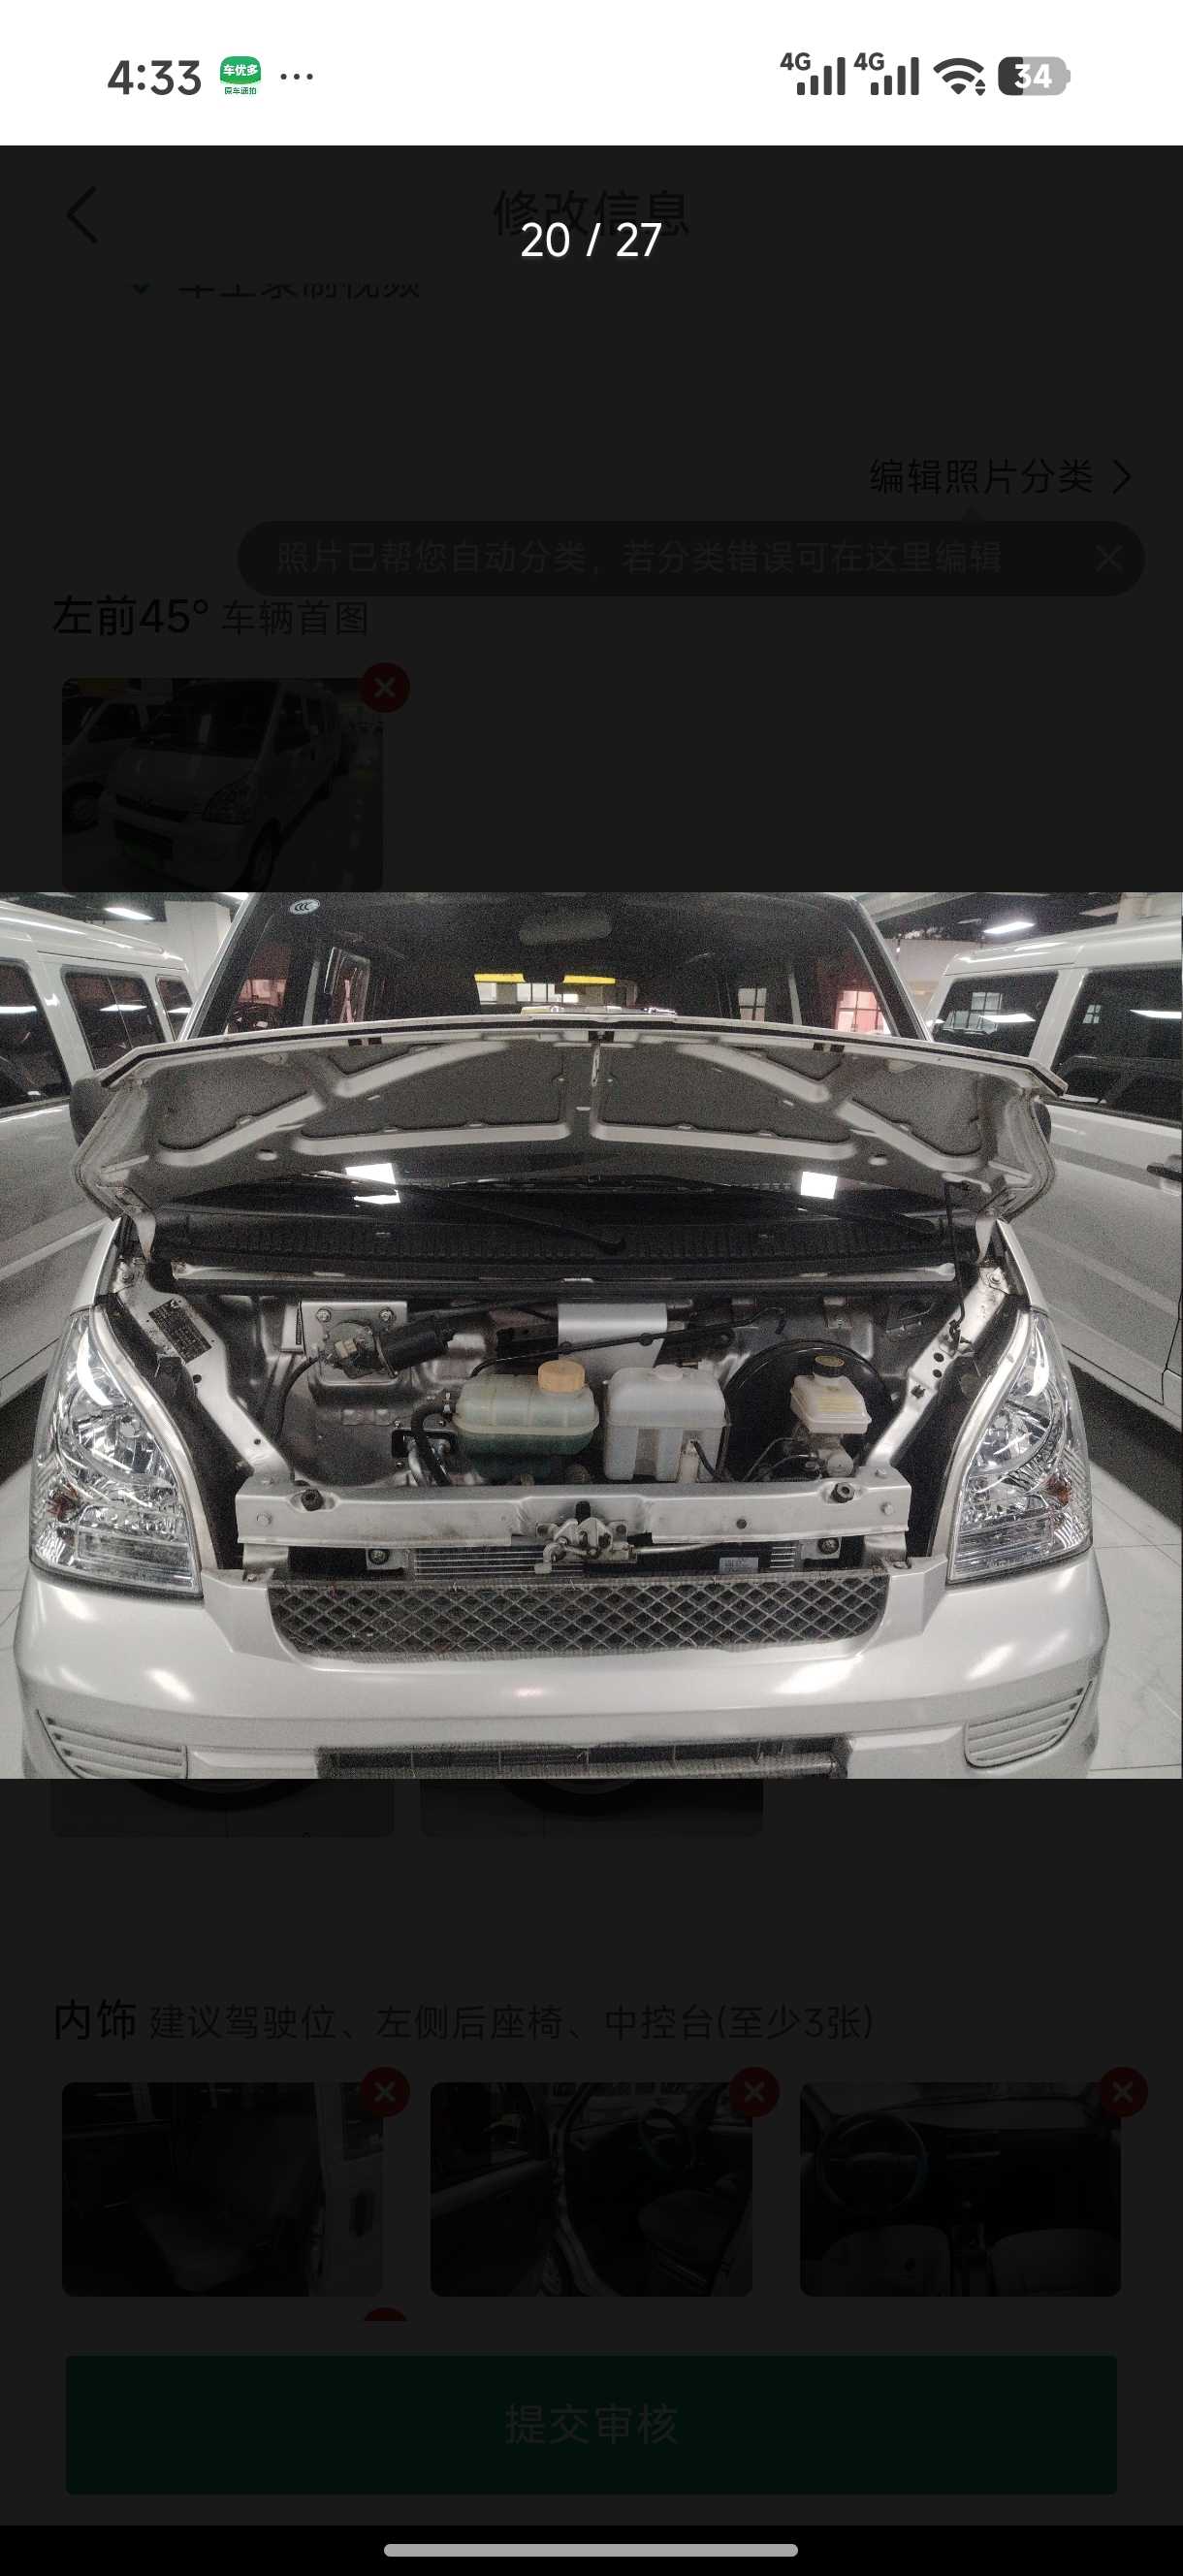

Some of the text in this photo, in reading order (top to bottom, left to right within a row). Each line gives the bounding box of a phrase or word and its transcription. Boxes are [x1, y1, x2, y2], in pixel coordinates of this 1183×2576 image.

[107, 60, 202, 96] 4:33
[223, 64, 259, 77] 车优多
[780, 51, 812, 71] 4G
[853, 51, 885, 71] 4G
[1013, 63, 1053, 89] 34
[494, 189, 690, 237] 修改信息
[521, 221, 571, 259] 20
[616, 221, 662, 258] 27
[869, 458, 1094, 495] 编辑照片分类
[276, 539, 1003, 575] 照片已帮您自动分类，若分类错误可在这里编辑
[220, 598, 369, 636] 车辆首图
[54, 1998, 873, 2041] 内饰 建议驾驶位、左侧后座椅、中控台(至少3张)
[504, 2402, 679, 2445] 提交审核
